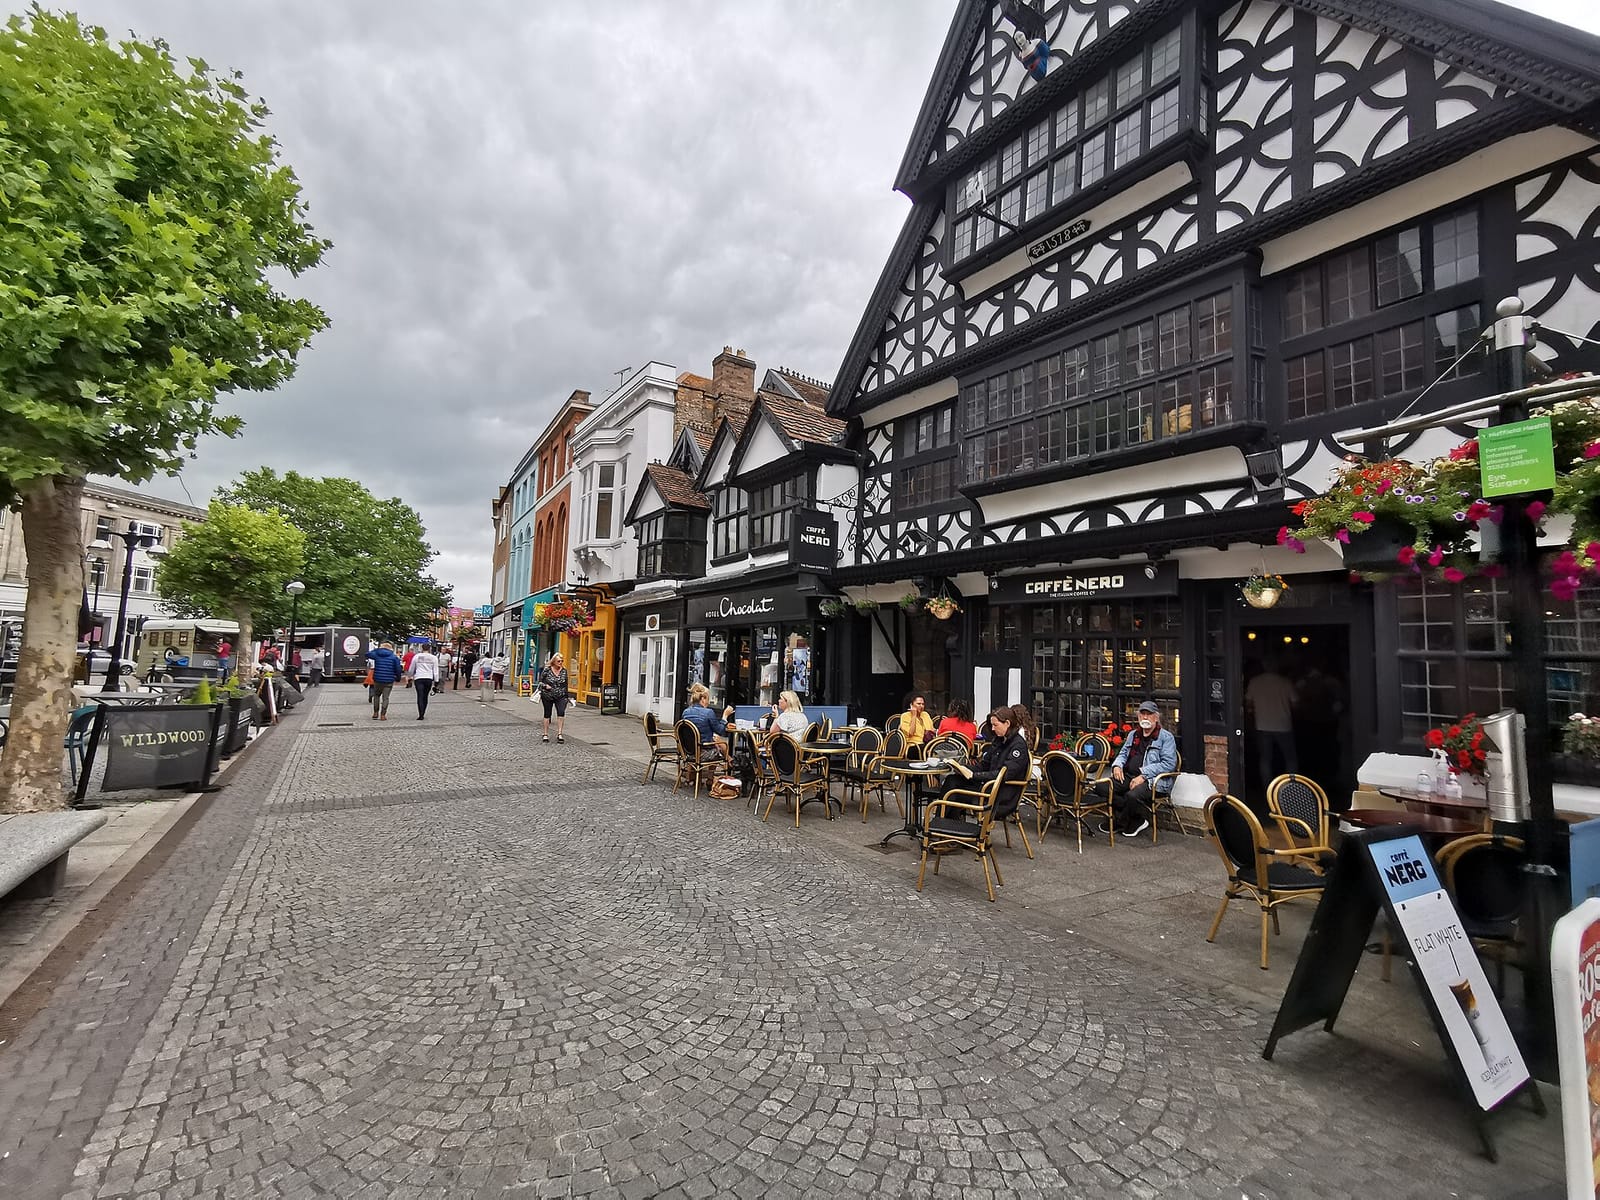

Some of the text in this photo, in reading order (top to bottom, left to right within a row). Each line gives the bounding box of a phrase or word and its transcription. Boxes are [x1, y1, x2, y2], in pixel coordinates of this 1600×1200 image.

[1046, 229, 1071, 249] 1578
[1488, 474, 1507, 482] Eye
[1488, 477, 1530, 489] Surgery
[800, 533, 830, 547] NERO
[1075, 575, 1124, 591] NERO
[705, 610, 720, 618] HOTEL
[120, 730, 205, 748] WILDWOOD
[1414, 924, 1462, 955] FLAT WHITE
